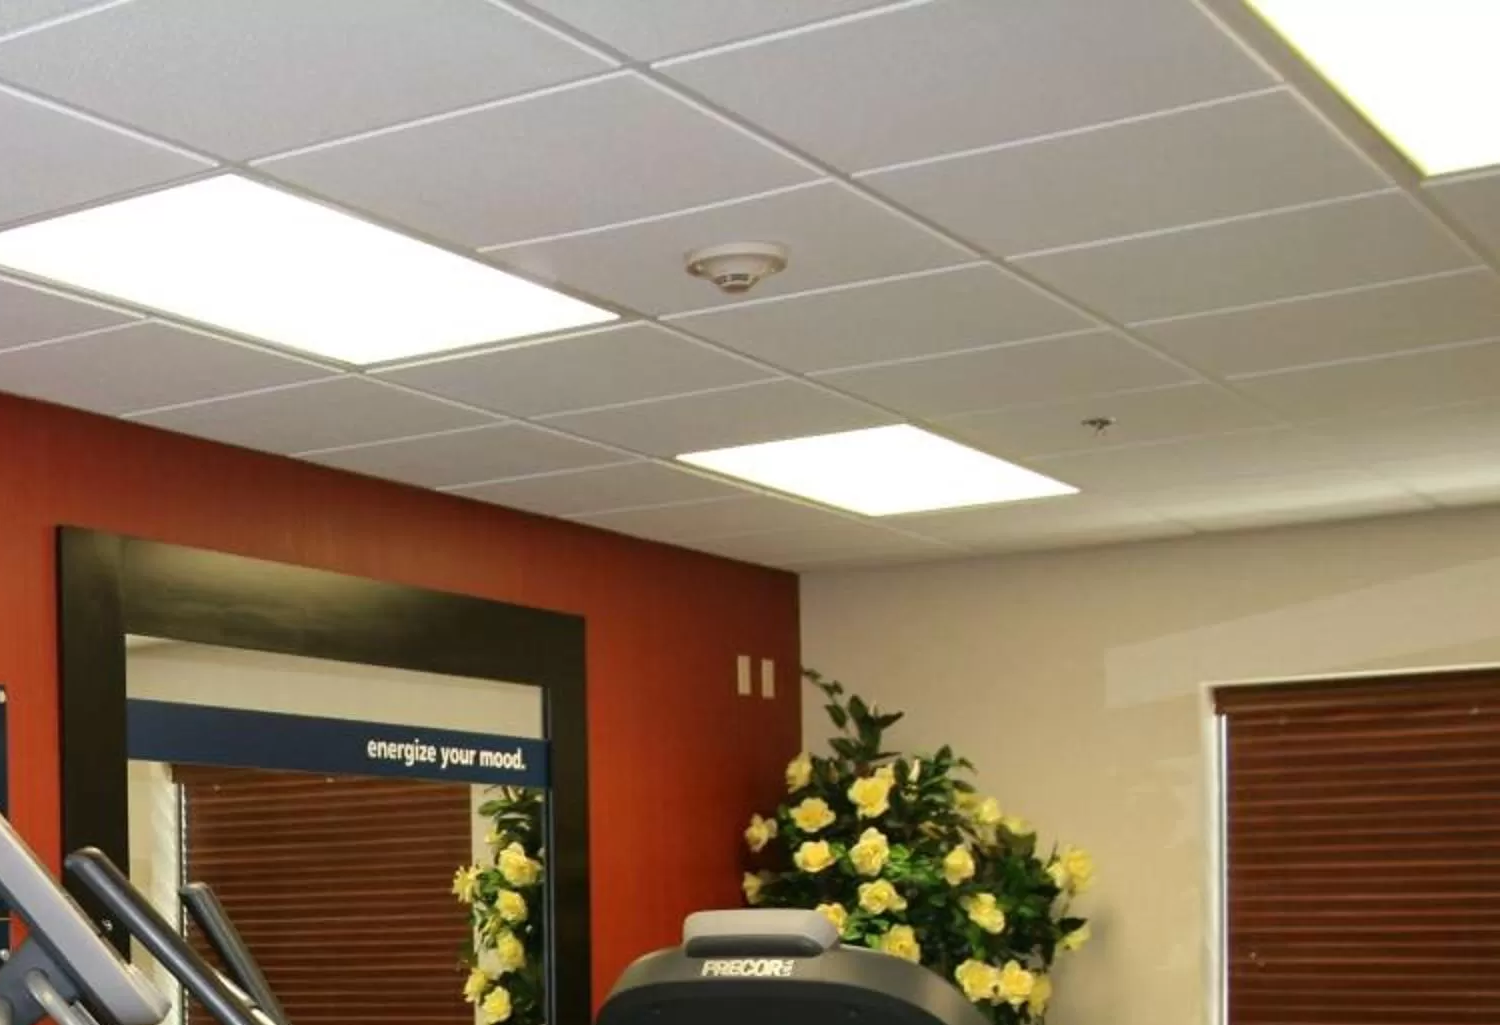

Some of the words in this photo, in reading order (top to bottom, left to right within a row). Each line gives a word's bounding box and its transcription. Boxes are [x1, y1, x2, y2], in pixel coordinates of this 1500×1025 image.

[367, 738, 437, 767] energize
[440, 747, 477, 770] your
[479, 747, 527, 770] mood.
